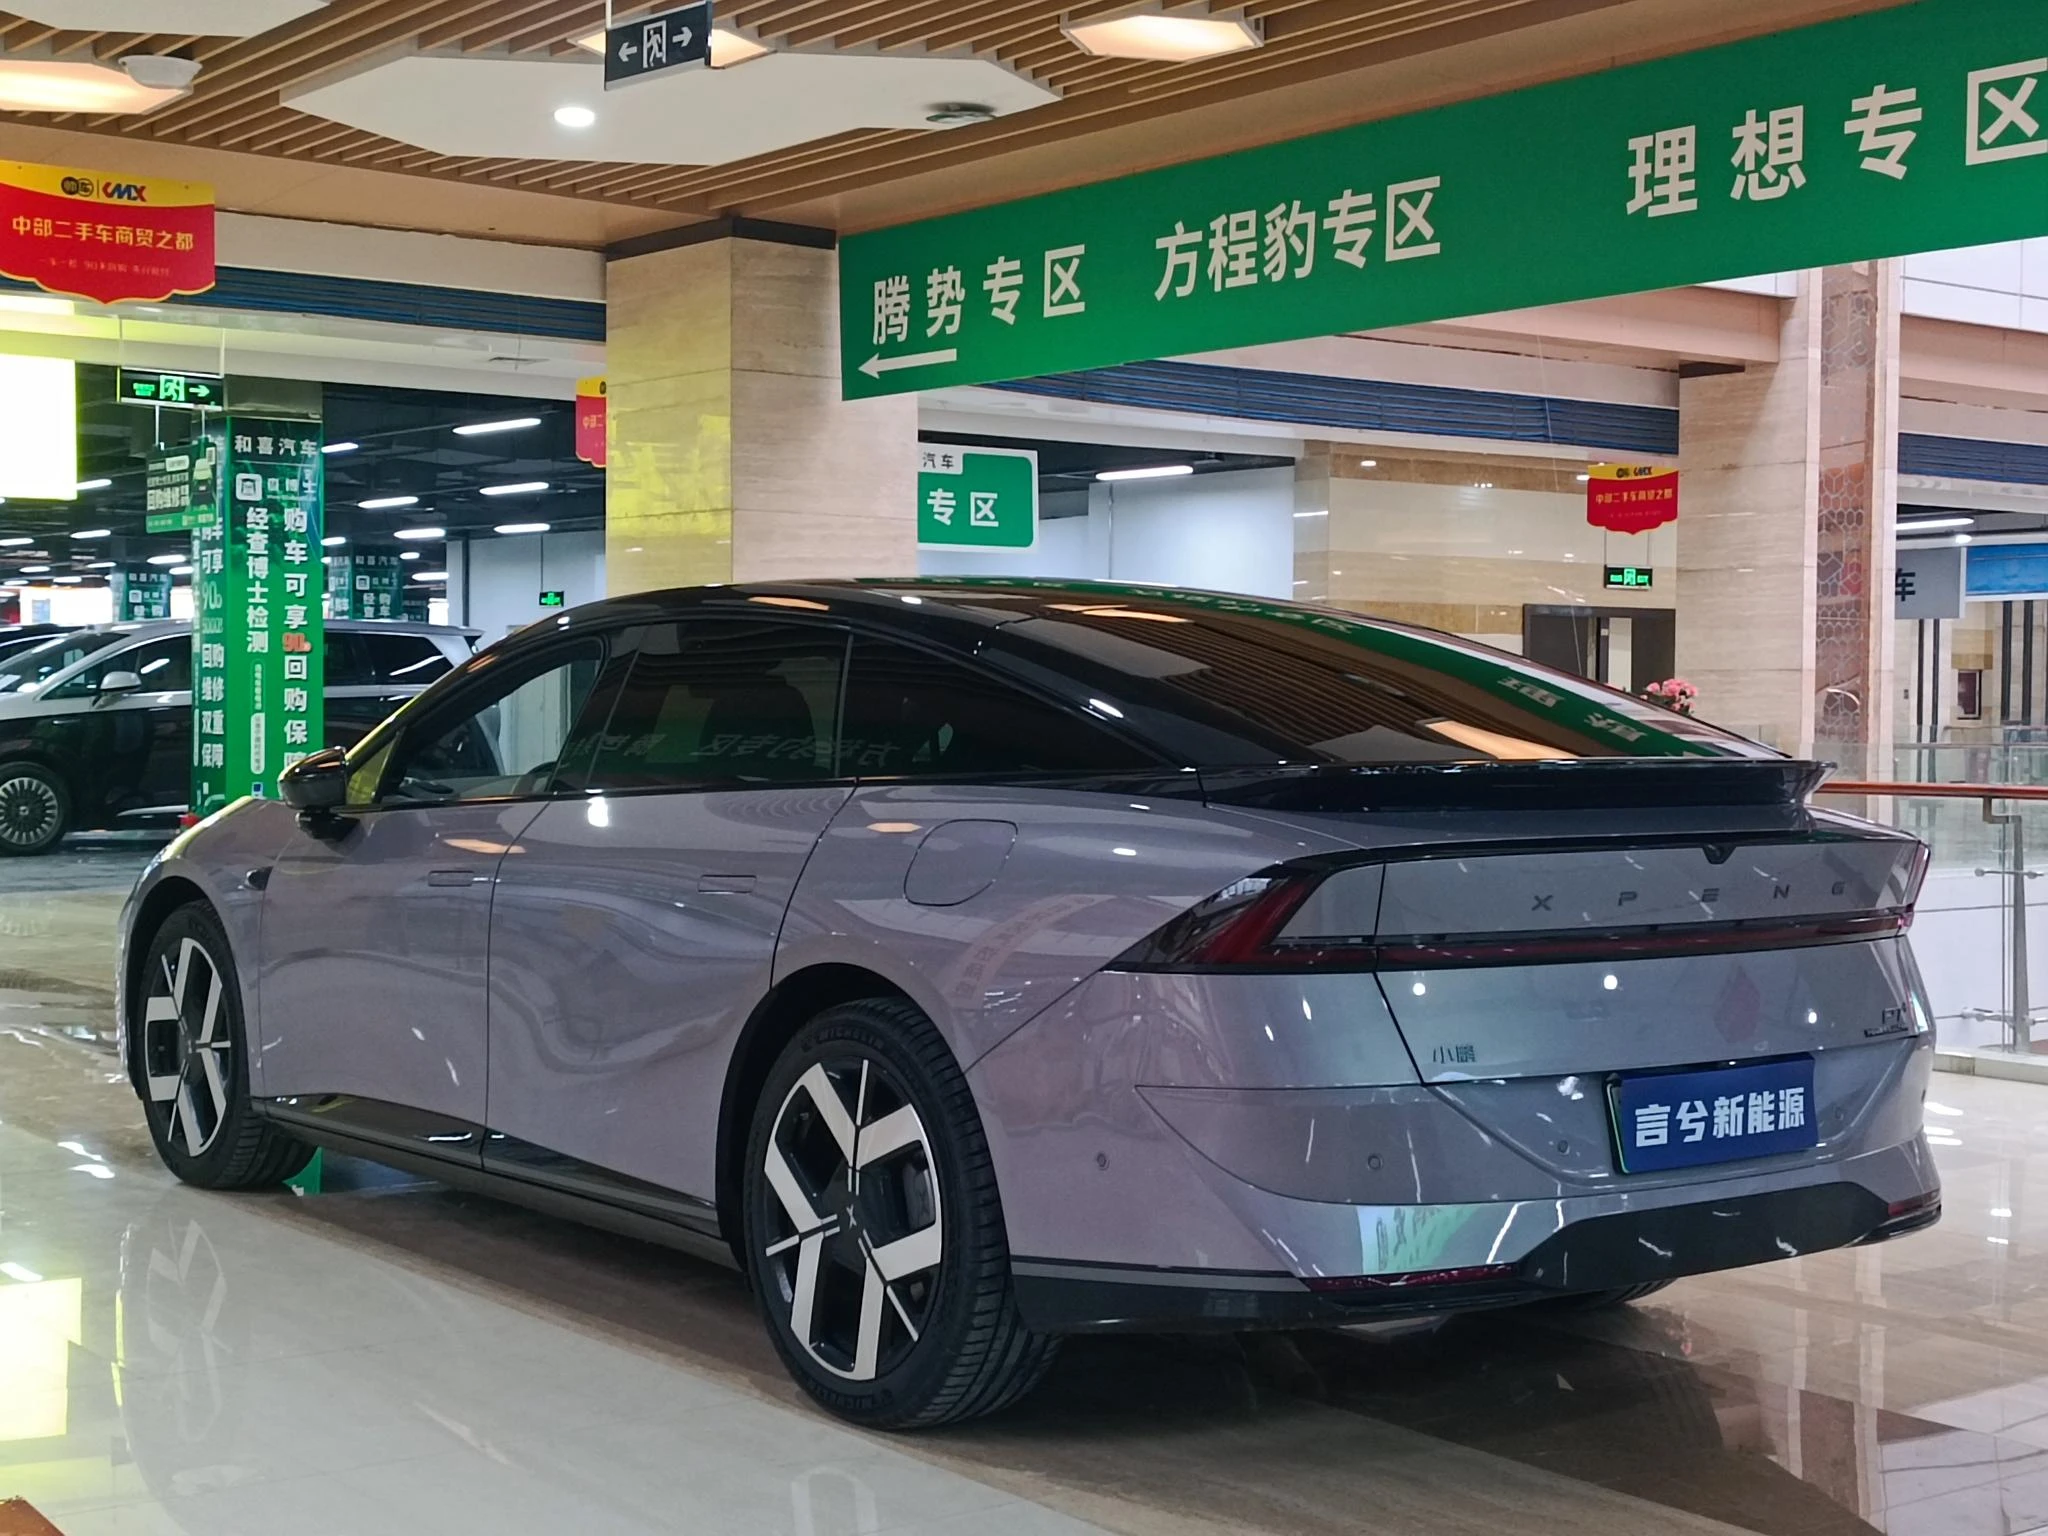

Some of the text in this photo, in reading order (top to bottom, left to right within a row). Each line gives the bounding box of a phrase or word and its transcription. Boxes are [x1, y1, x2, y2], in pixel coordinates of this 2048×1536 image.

[872, 57, 2048, 346] 腾势专区 方程豹专区 理想专区
[12, 215, 194, 251] 中部二手车商贸之都
[234, 434, 318, 459] 和喜汽车
[922, 451, 955, 470] 汽车
[926, 487, 1000, 528] 专区
[246, 506, 270, 653] 经查博士检测
[1531, 880, 1847, 912] XPENG
[1634, 1086, 1805, 1148] 言兮新能源
